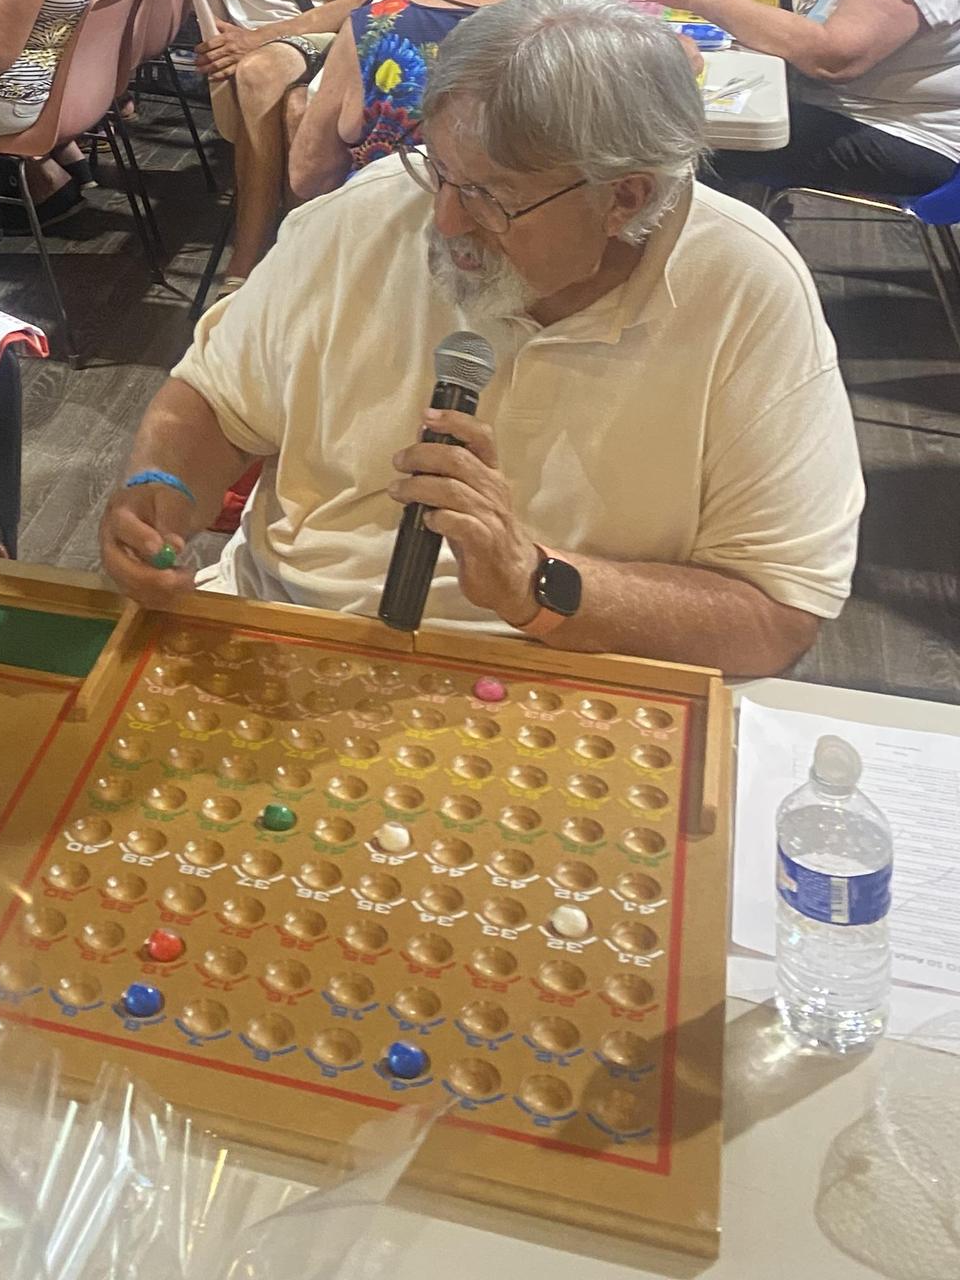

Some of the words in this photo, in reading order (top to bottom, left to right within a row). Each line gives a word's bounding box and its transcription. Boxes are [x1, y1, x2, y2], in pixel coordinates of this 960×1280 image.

[66, 842, 98, 854] 40
[121, 853, 154, 866] 39
[370, 853, 404, 865] 45
[179, 865, 211, 878] 38
[431, 865, 464, 877] 44
[236, 877, 270, 890] 37
[491, 876, 526, 889] 43
[296, 888, 330, 902] 36
[554, 888, 590, 901] 42
[357, 900, 391, 914] 35
[624, 901, 656, 914] 41
[419, 913, 453, 927] 34
[482, 925, 518, 940] 33
[547, 939, 583, 953] 32
[619, 952, 651, 967] 31
